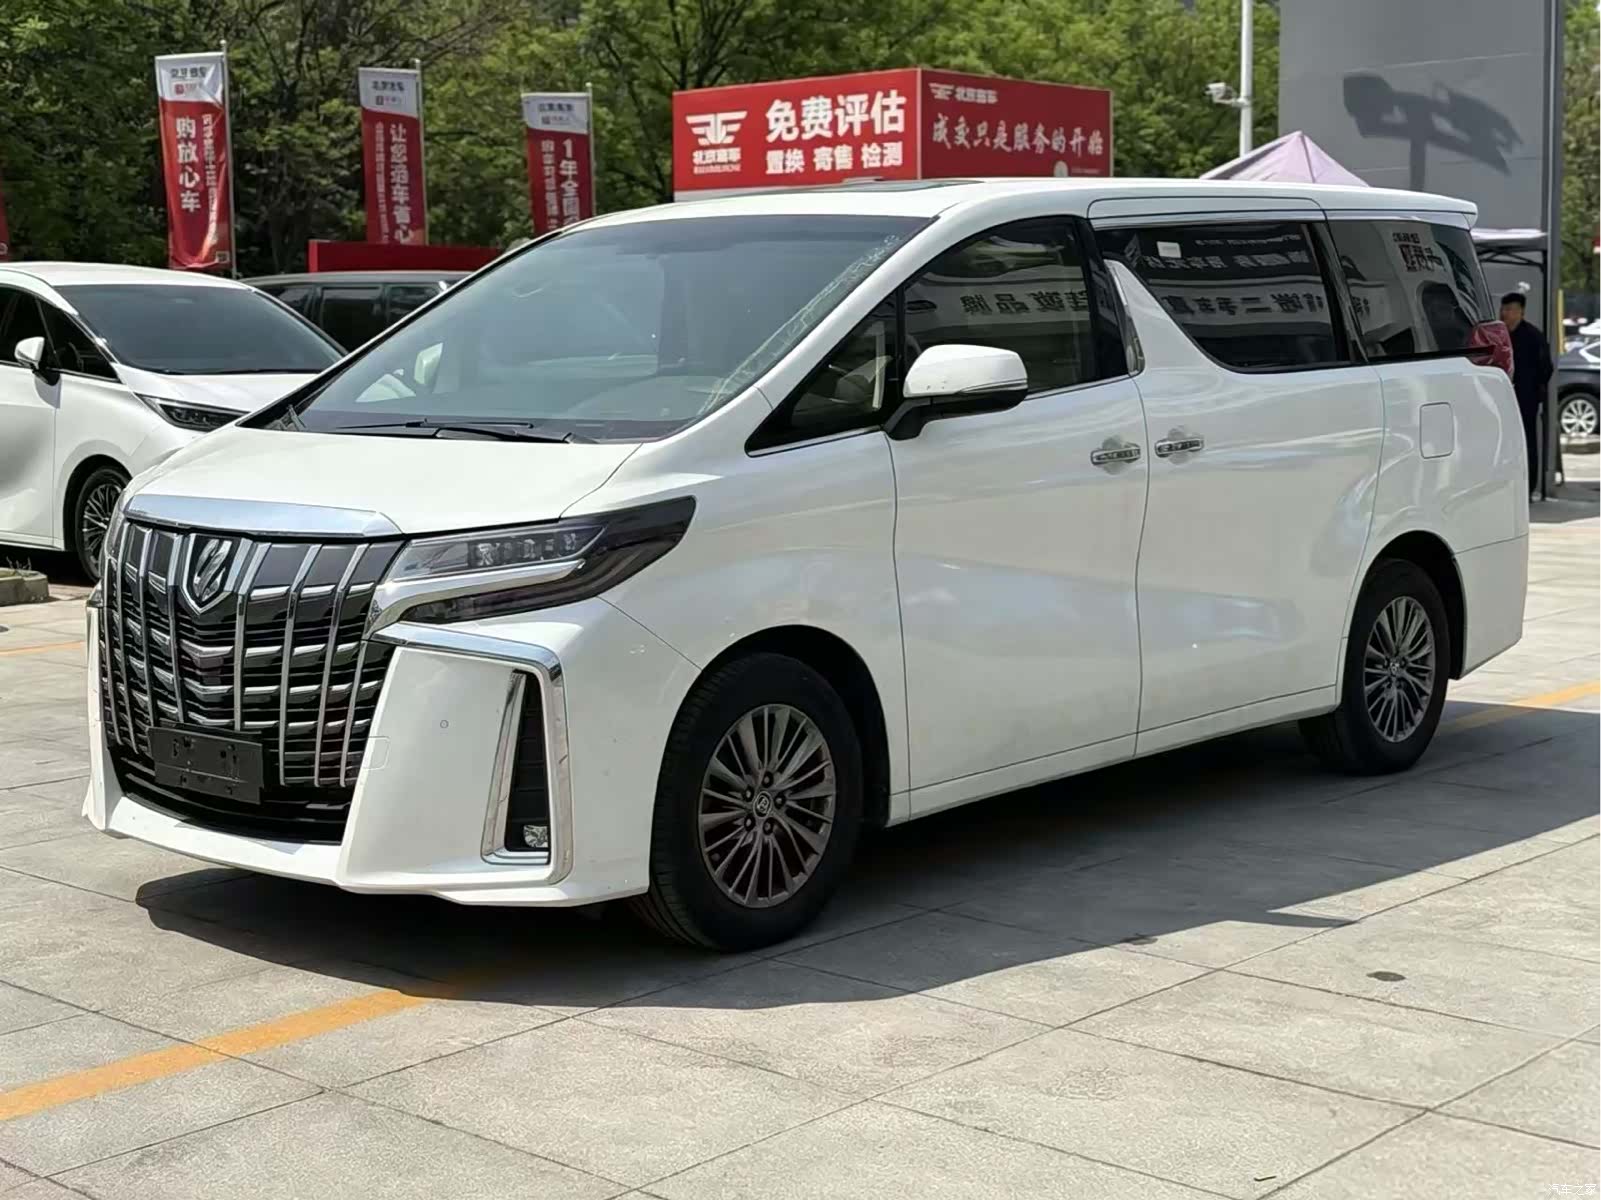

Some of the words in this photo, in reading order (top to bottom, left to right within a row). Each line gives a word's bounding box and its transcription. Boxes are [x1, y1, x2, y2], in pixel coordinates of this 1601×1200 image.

[765, 90, 907, 143] 免费评估
[932, 113, 1104, 159] 成交只是服务的开始
[176, 116, 201, 213] 购放心车
[765, 149, 805, 175] 置换
[813, 144, 853, 172] 寄售
[861, 141, 903, 169] 检测
